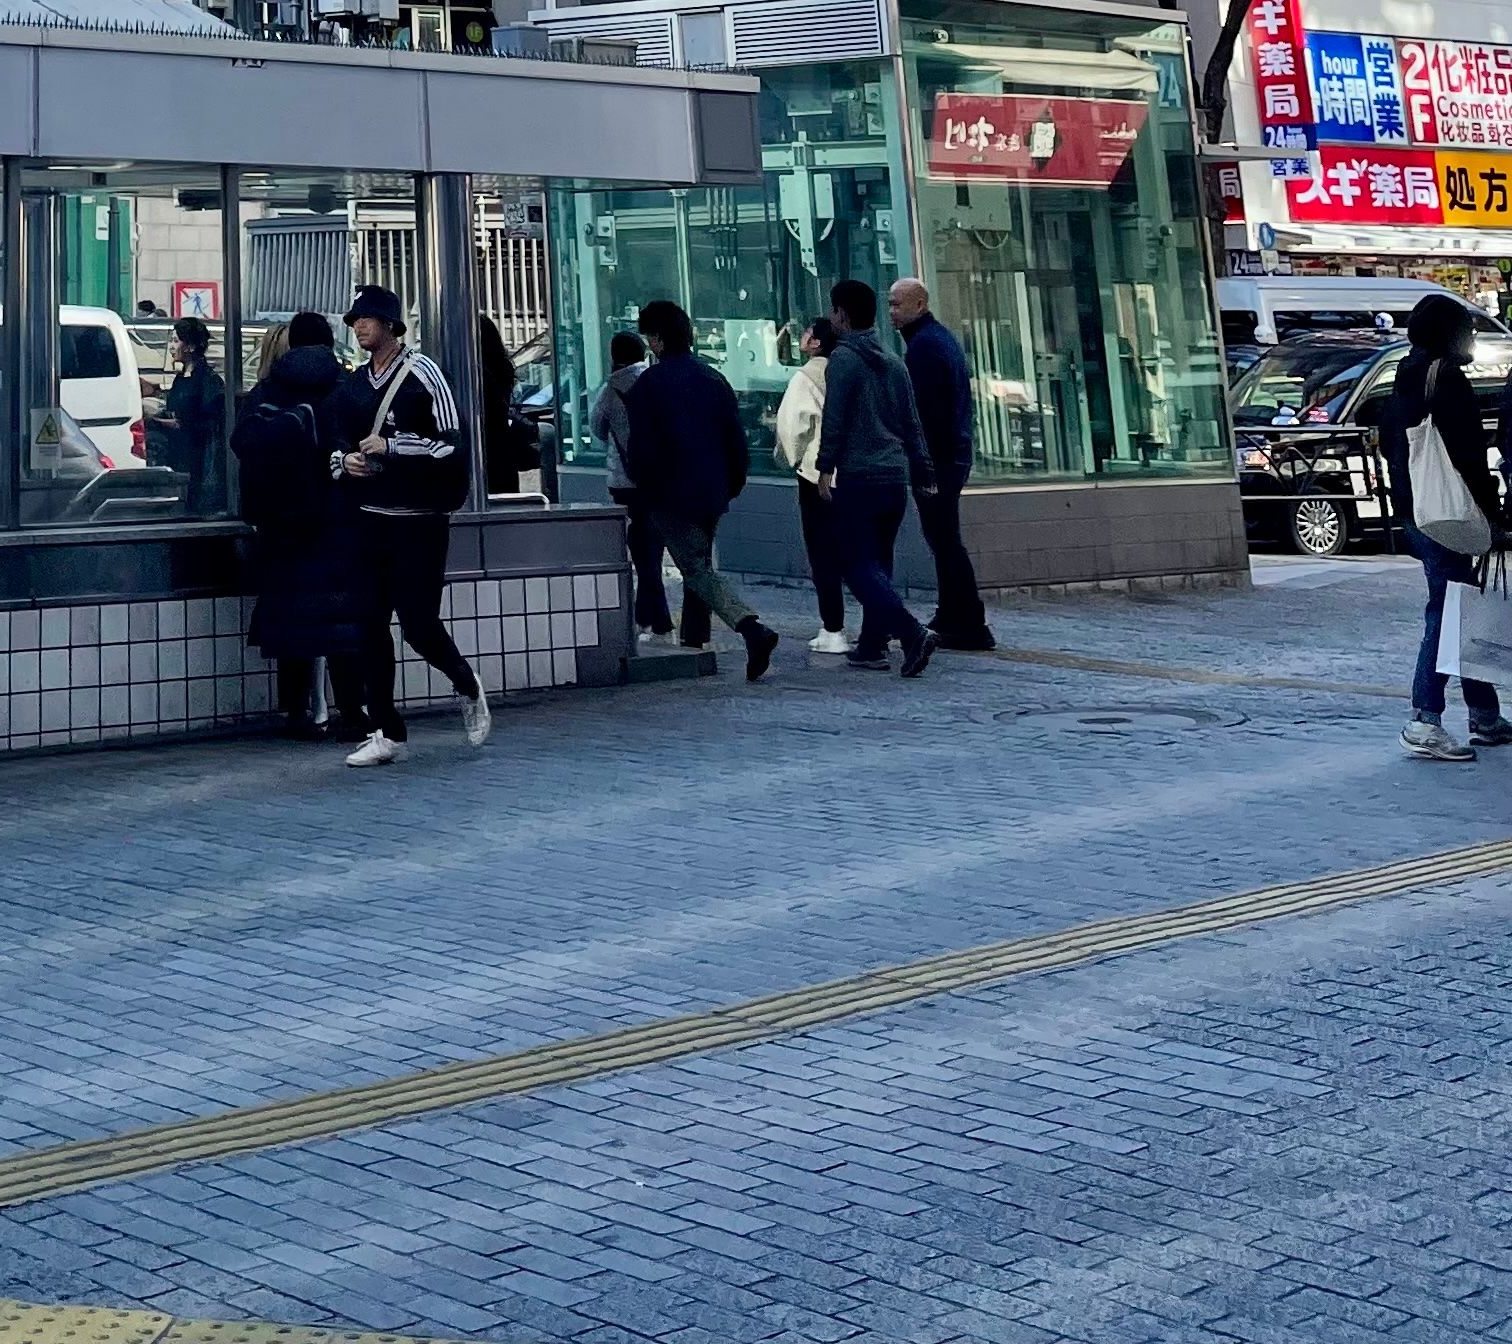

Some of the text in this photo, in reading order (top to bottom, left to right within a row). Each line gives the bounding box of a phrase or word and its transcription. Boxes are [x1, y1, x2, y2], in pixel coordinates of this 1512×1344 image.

[1321, 49, 1359, 76] hour
[1319, 75, 1371, 126] 時間
[1365, 41, 1406, 140] 営業
[1445, 164, 1508, 212] 処方
